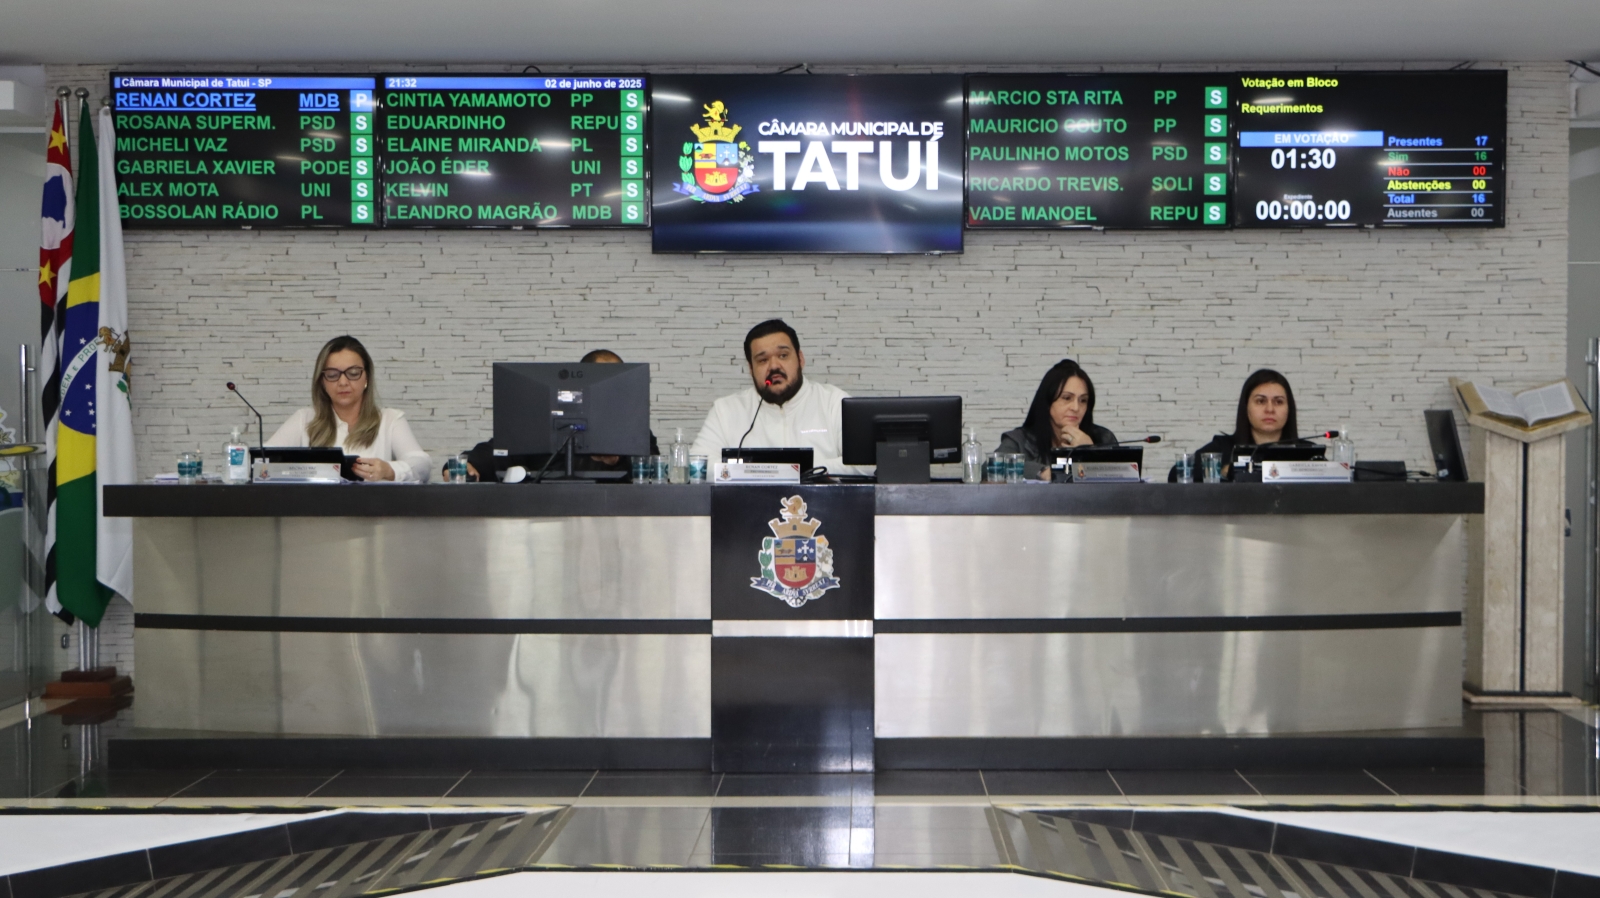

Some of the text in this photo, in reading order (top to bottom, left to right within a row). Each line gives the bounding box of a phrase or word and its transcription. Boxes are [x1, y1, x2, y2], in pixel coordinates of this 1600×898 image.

[122, 78, 159, 87] Câmara
[162, 78, 209, 89] Municipal
[211, 79, 223, 87] de
[226, 79, 250, 87] Tatuí
[258, 79, 272, 87] SP
[389, 79, 417, 87] 21:32
[545, 79, 642, 90] 02 de junho de 2025
[1242, 78, 1285, 89] Votação
[1307, 78, 1338, 87] Bloco
[116, 93, 255, 107] RENAN CORTEZ
[299, 93, 366, 107] MDB P
[387, 93, 551, 107] CINTIA YAMAMOTO
[571, 93, 637, 108] PP S
[970, 91, 1123, 105] MARCIO STA RITA
[1154, 90, 1222, 105] PP S
[1242, 104, 1323, 114] Requerimentos
[117, 116, 276, 130] ROSANA SUPERM.
[300, 116, 367, 130] PSD S
[387, 115, 505, 130] EDUARDINHO
[571, 115, 637, 130] REPU S
[758, 118, 943, 135] CÂMARA MUNICIPAL DE
[970, 119, 1127, 133] MAURICIO COUTO
[1154, 118, 1222, 133] PP S
[117, 138, 227, 152] MICHELI VAZ
[301, 138, 367, 153] PSD S
[388, 138, 542, 152] ELAINE MIRANDA
[571, 137, 637, 152] PL S
[1274, 133, 1349, 145] EM VOTAÇÃO
[1388, 136, 1488, 147] Presentes 17
[970, 147, 1129, 161] PAULINHO MOTOS
[1152, 146, 1222, 161] PSD S
[1271, 148, 1336, 169] 01:30
[1388, 152, 1487, 162] Sim 16
[117, 160, 276, 175] GABRIELA XAVIER
[301, 161, 368, 175] PODE S
[387, 157, 489, 175] JOÃO ÉDER
[571, 160, 637, 175] UNI S
[758, 134, 943, 191] TATUÍ
[1388, 166, 1486, 176] Não 00
[118, 183, 219, 196] ALEX MOTA
[301, 183, 368, 198] UNI S
[387, 183, 448, 197] KELVIN
[571, 182, 637, 198] PT S
[970, 177, 1123, 191] RICARDO TREVIS.
[1152, 176, 1221, 192] SOLI S
[1388, 180, 1486, 191] Abstenções 00
[1388, 194, 1485, 204] Total 16
[120, 202, 279, 219] BOSSOLAN RÁDIO
[302, 205, 368, 220] PL S
[387, 202, 557, 220] LEANDRO MAGRÃO
[573, 205, 637, 220] MDB S
[970, 206, 1097, 220] VADE MANOEL
[1151, 205, 1221, 221] REPU S
[1256, 200, 1350, 221] 00:00:00
[1387, 208, 1484, 218] Ausentes 00
